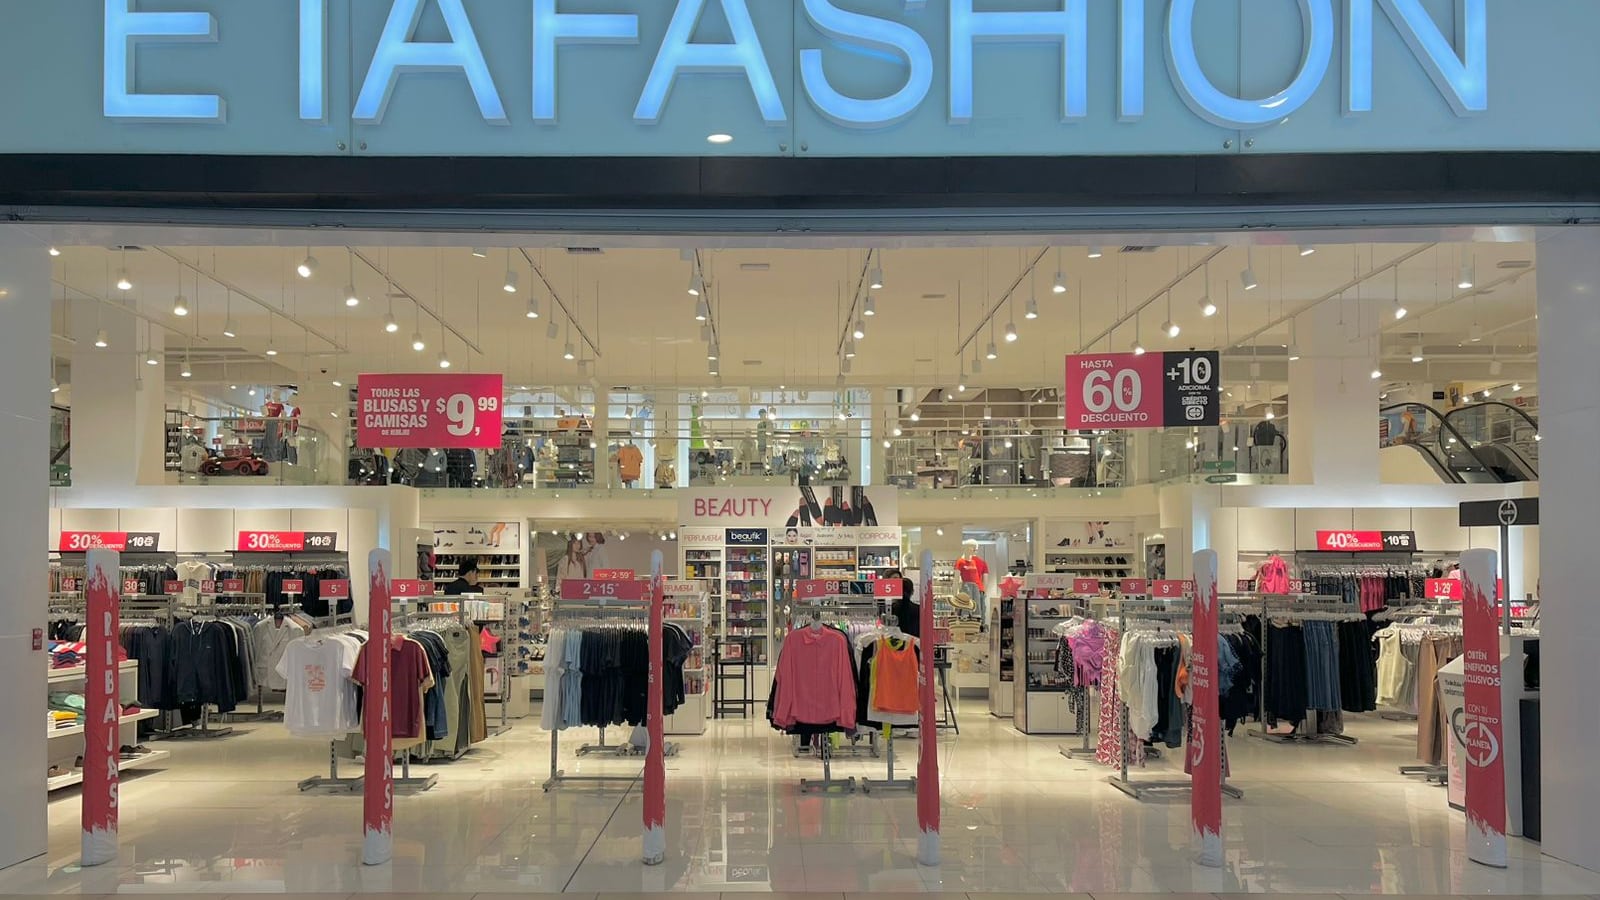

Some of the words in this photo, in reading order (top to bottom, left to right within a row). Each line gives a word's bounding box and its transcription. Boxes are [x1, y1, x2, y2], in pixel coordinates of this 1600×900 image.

[1080, 360, 1114, 369] HASTA
[371, 388, 400, 397] TODAS
[402, 388, 420, 397] LAS
[363, 399, 417, 413] BLUSAS
[421, 399, 430, 413] Y
[365, 414, 428, 428] CAMISAS
[1081, 412, 1148, 423] DESCUENTO
[694, 498, 773, 517] BEAUTY
[69, 533, 102, 549] 30%
[248, 533, 280, 548] 30%
[859, 532, 897, 541] CORPORAL
[1326, 532, 1359, 548] 40%
[125, 580, 138, 591] 30
[202, 581, 215, 592] 40
[825, 580, 839, 591] 60
[1289, 580, 1302, 591] 30
[1467, 650, 1488, 660] OBTÉN
[1464, 674, 1501, 686] XCLUSIVOS
[381, 608, 391, 810] REBAJAS
[1467, 704, 1480, 713] CON
[1466, 738, 1491, 751] PLANETA
